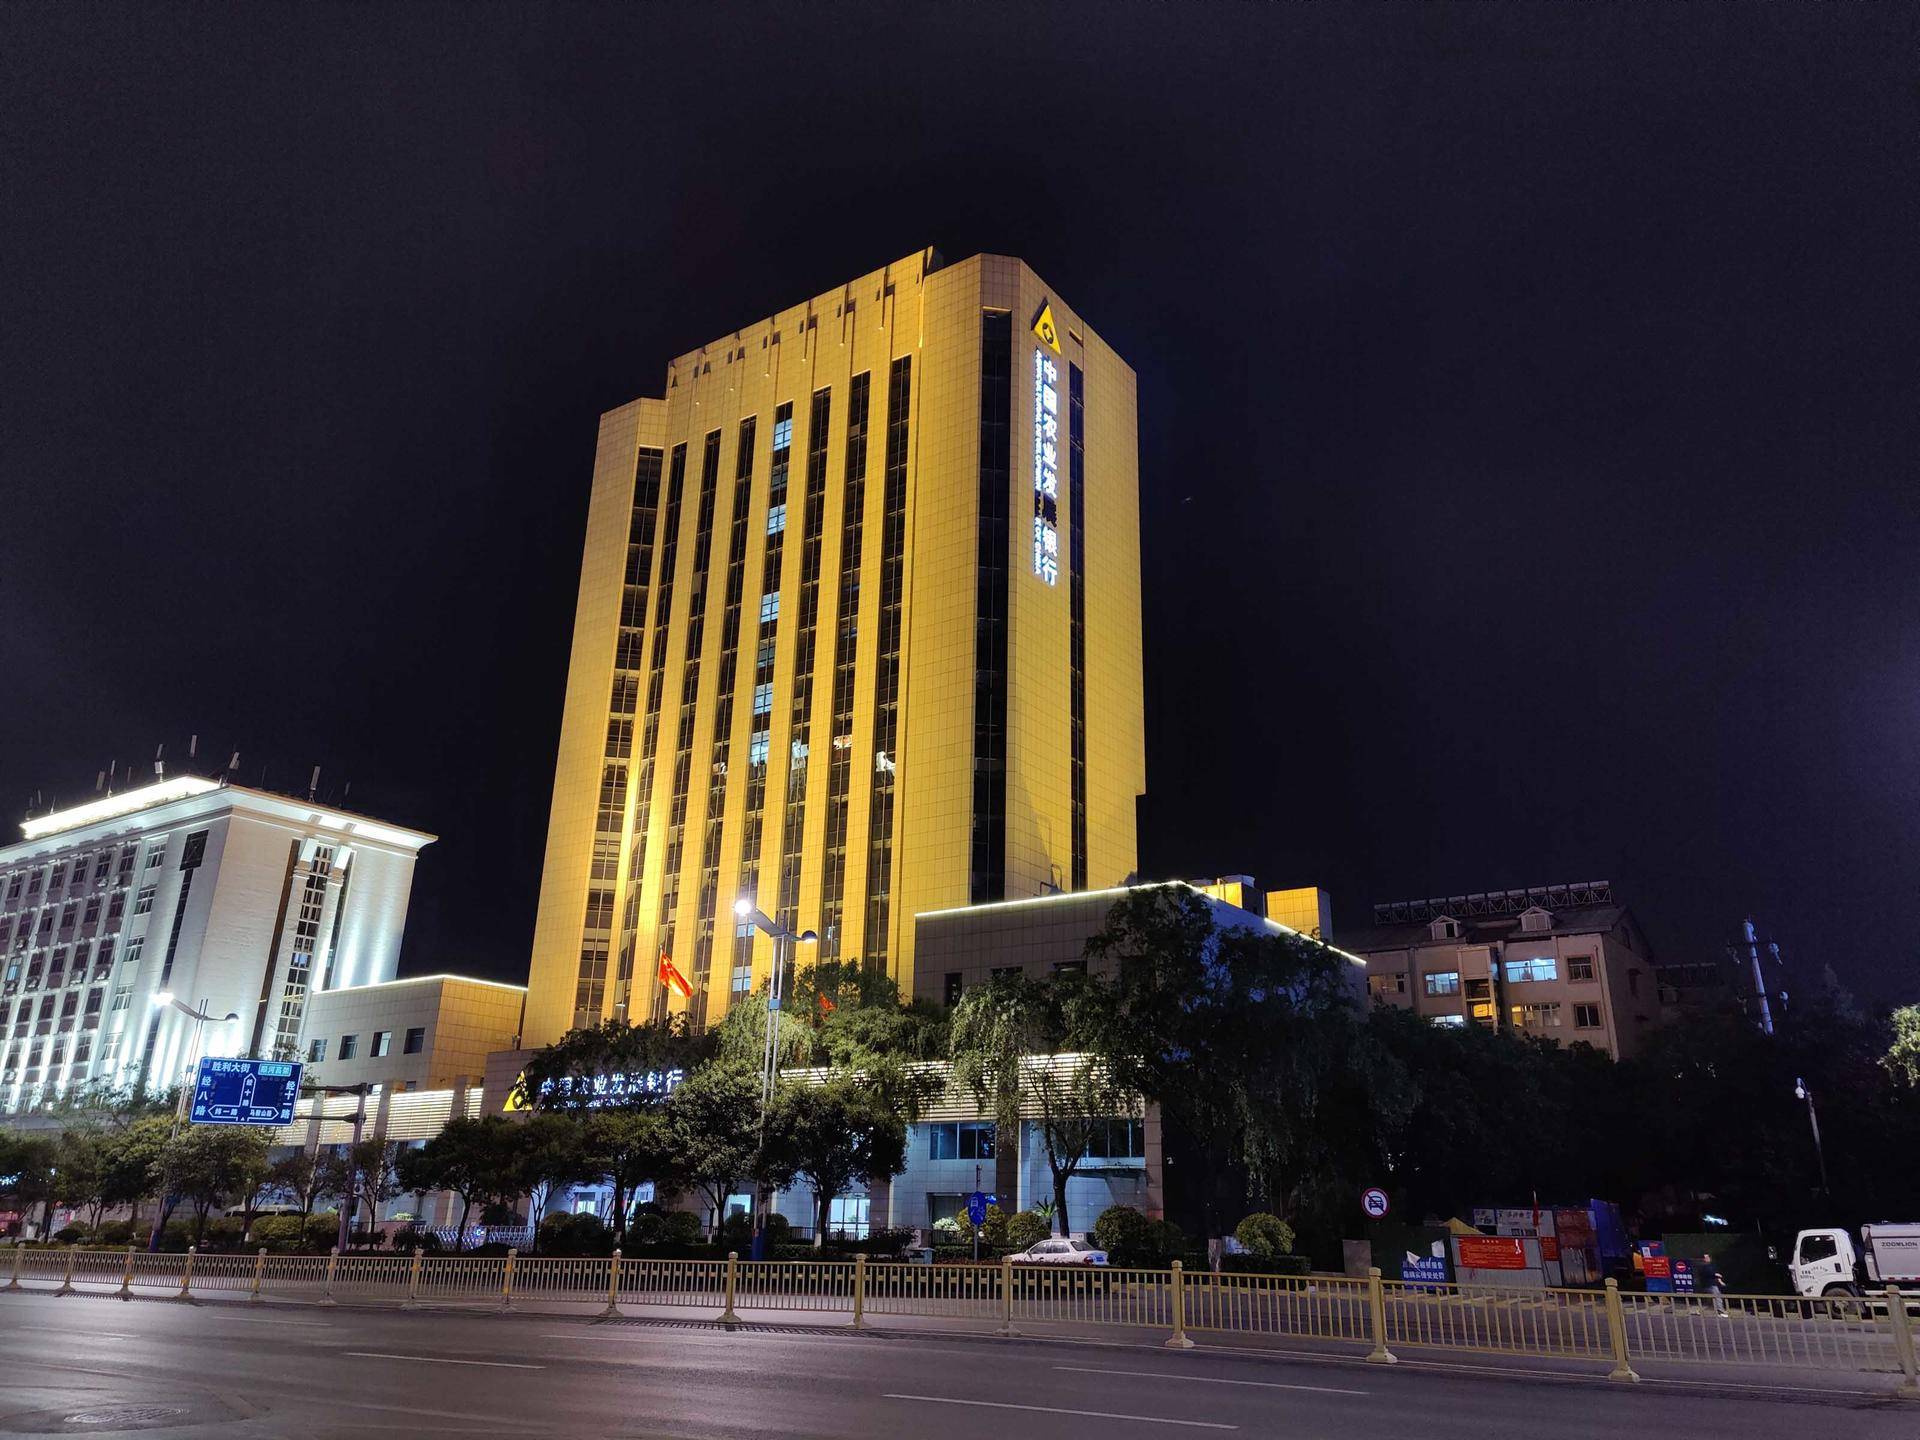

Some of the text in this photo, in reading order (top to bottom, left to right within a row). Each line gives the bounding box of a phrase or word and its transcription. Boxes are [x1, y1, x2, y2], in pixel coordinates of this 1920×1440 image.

[211, 1061, 251, 1073] 胜利大街
[195, 1075, 212, 1116] 经八路
[242, 1079, 254, 1107] 经十路
[280, 1080, 296, 1119] 经十一路
[214, 1107, 238, 1116] 纬一路
